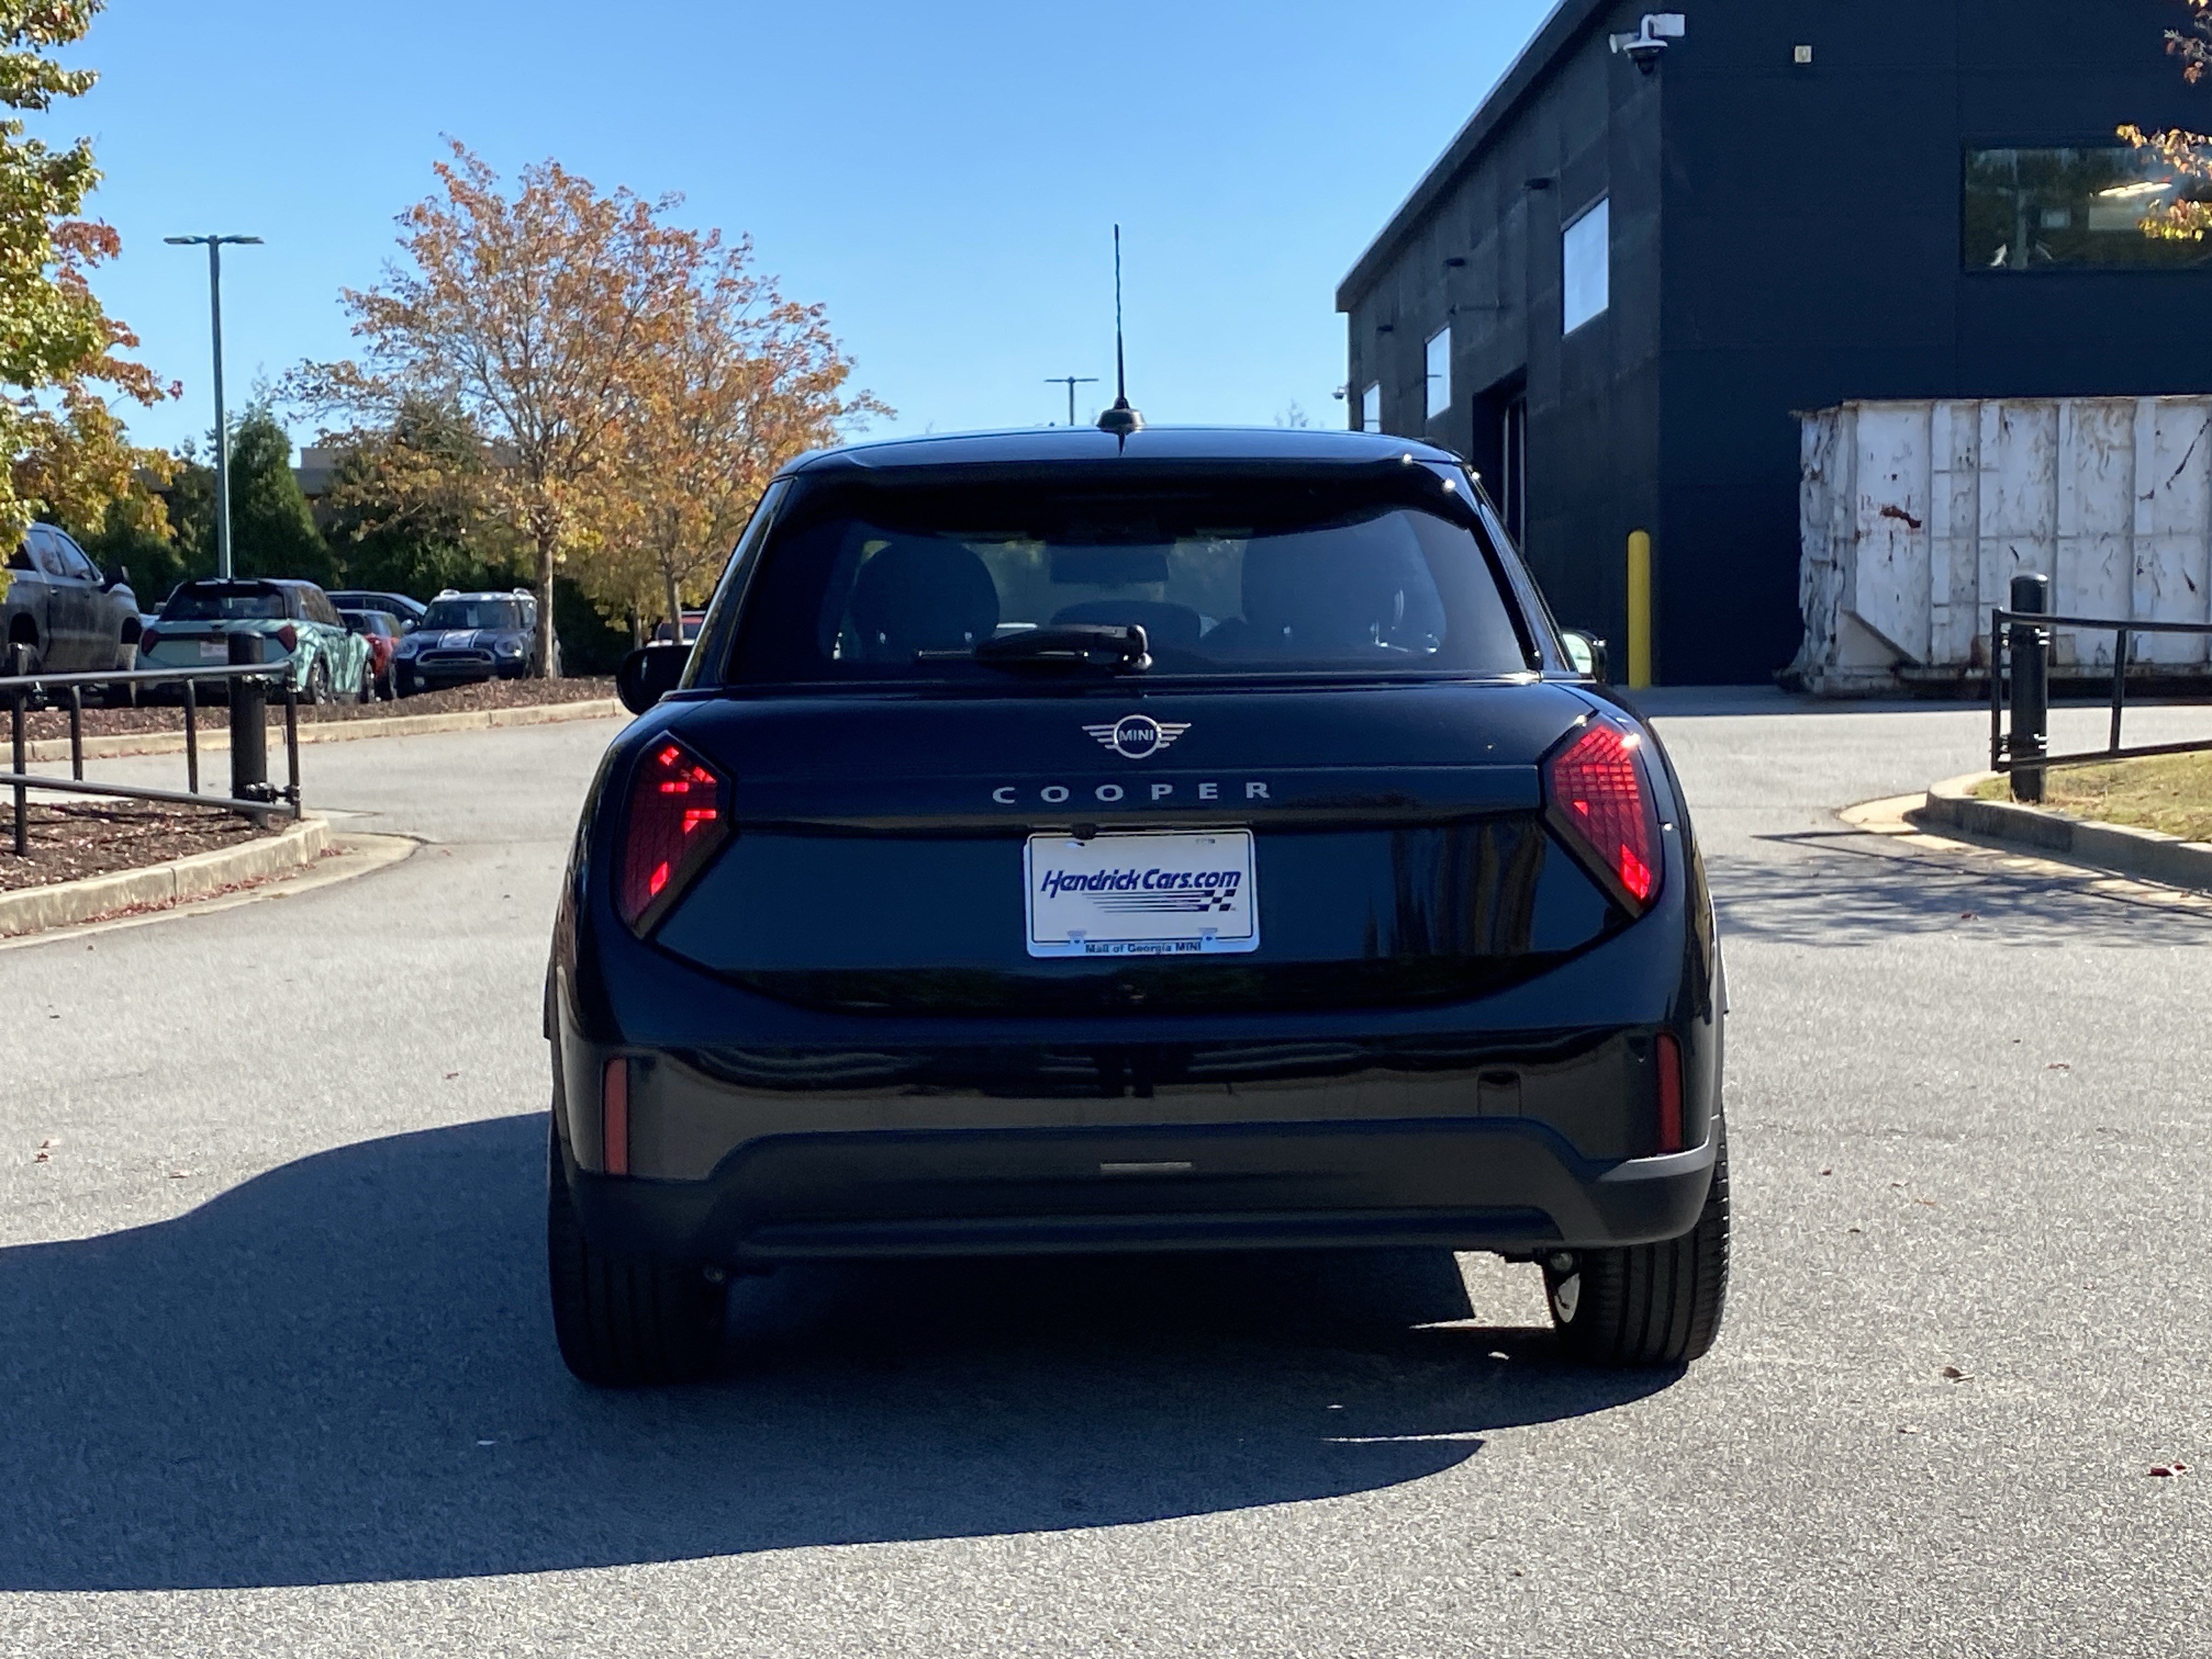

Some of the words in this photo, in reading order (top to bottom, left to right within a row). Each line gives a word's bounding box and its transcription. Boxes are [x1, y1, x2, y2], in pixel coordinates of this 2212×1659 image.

[1118, 729, 1154, 742] MINI
[992, 781, 1271, 804] COOPER
[1085, 944, 1109, 953] Mall
[1113, 944, 1123, 953] of
[1127, 943, 1172, 955] Georgia
[1175, 942, 1201, 951] MINI
